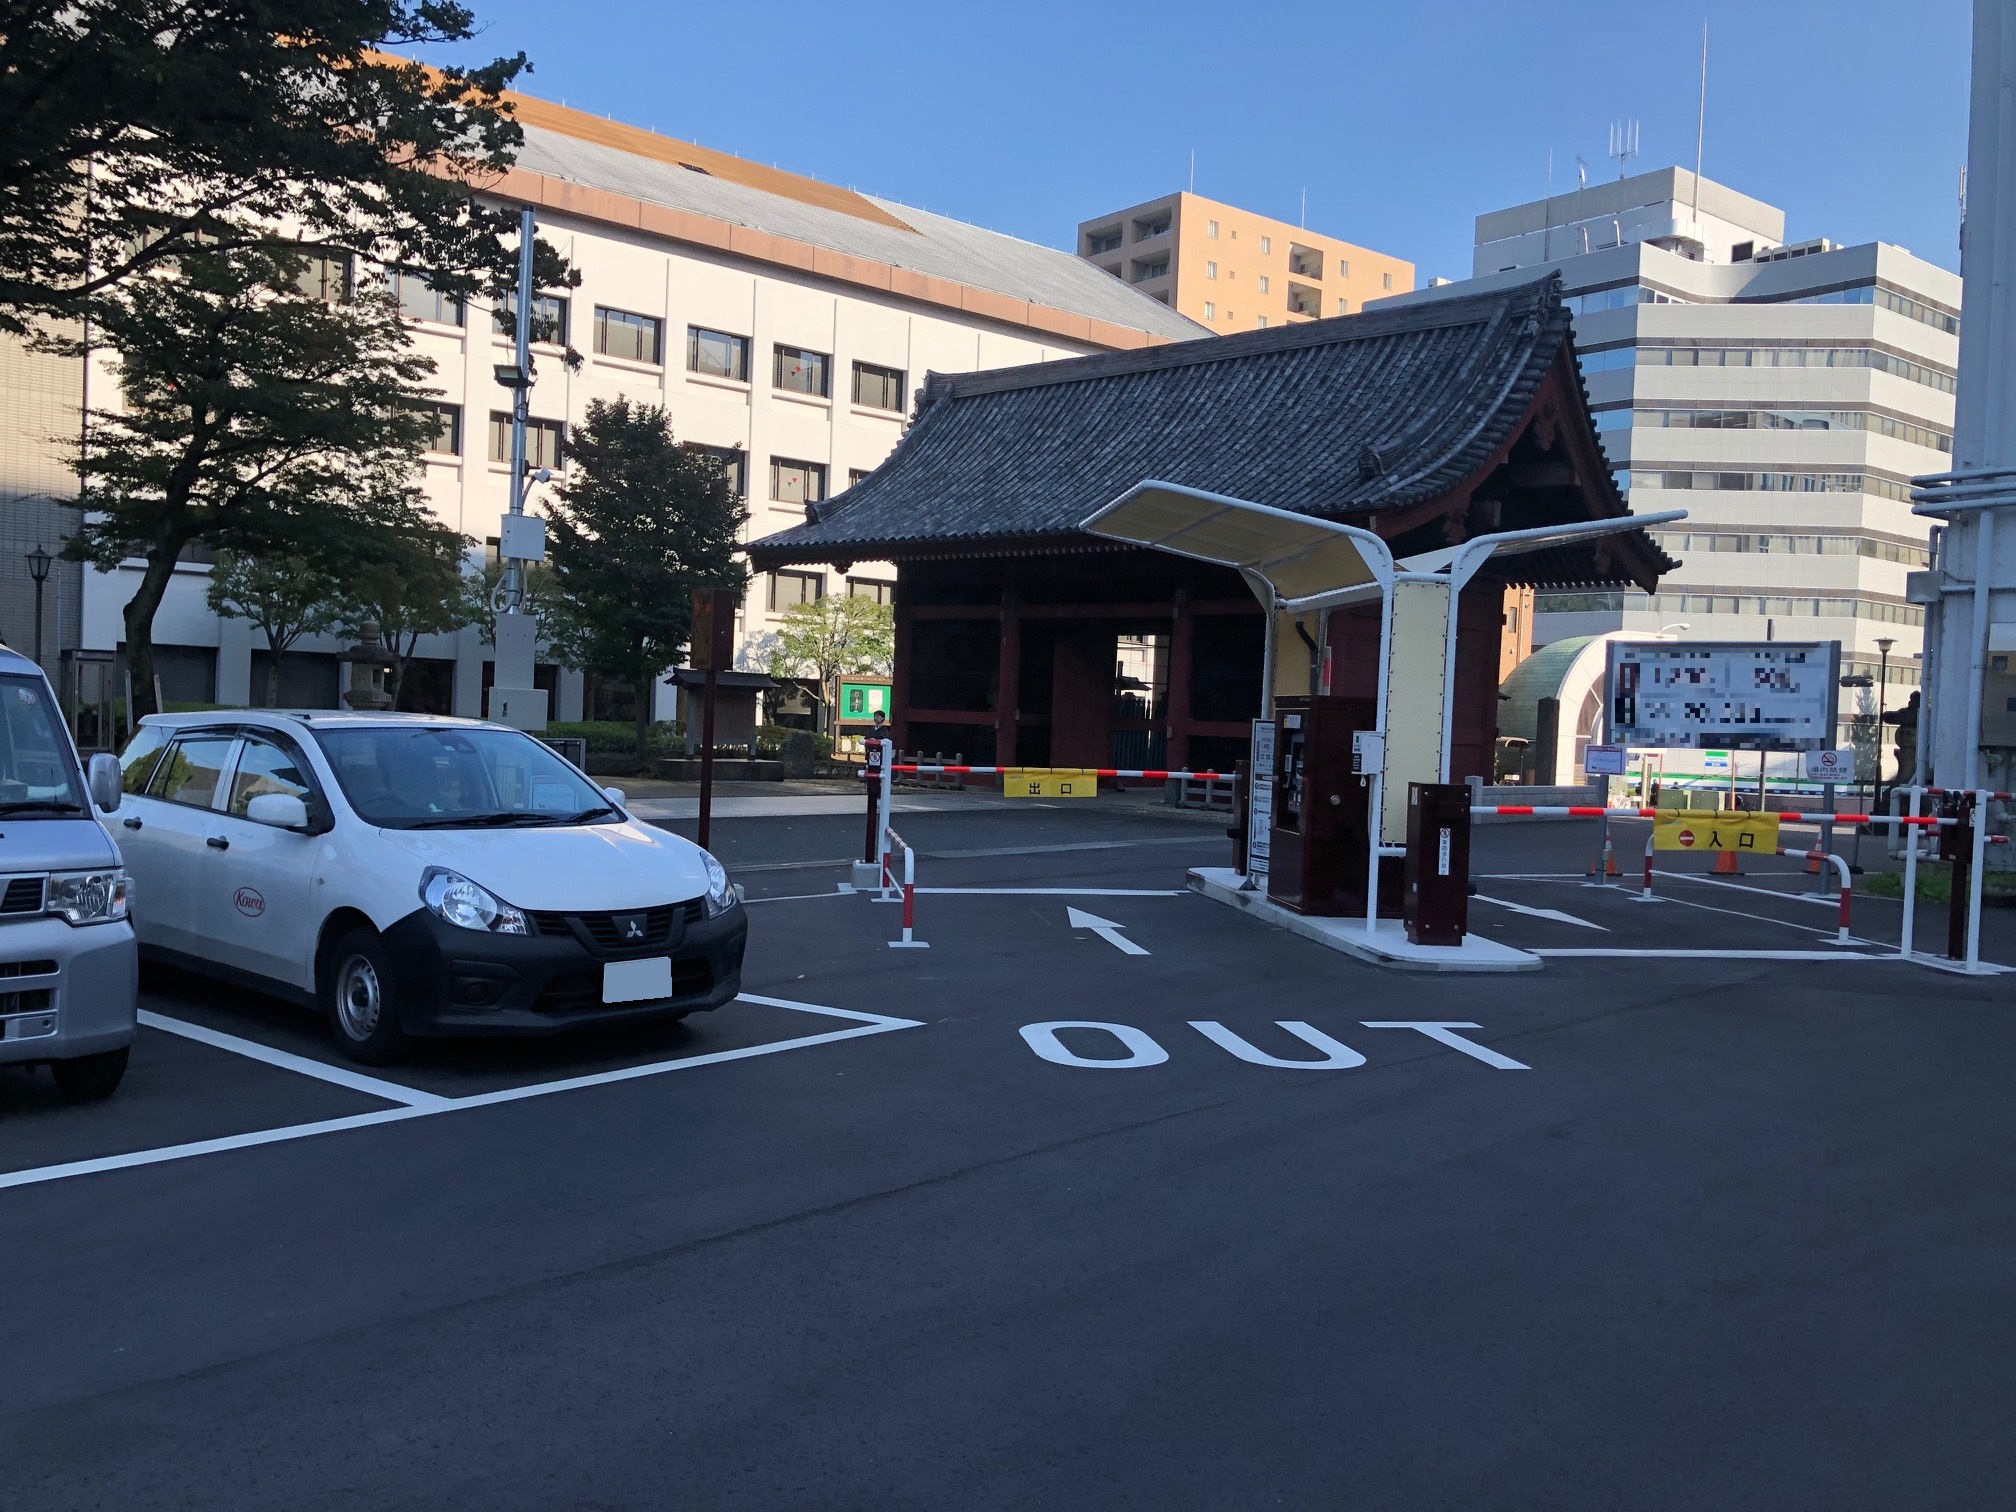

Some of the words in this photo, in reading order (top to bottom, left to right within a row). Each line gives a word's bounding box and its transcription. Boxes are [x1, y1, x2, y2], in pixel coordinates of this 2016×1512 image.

[1811, 766, 1848, 774] 場内禁煙
[1029, 782, 1072, 795] 出口
[1709, 830, 1755, 848] 入口
[1018, 1020, 1533, 1070] OUT
